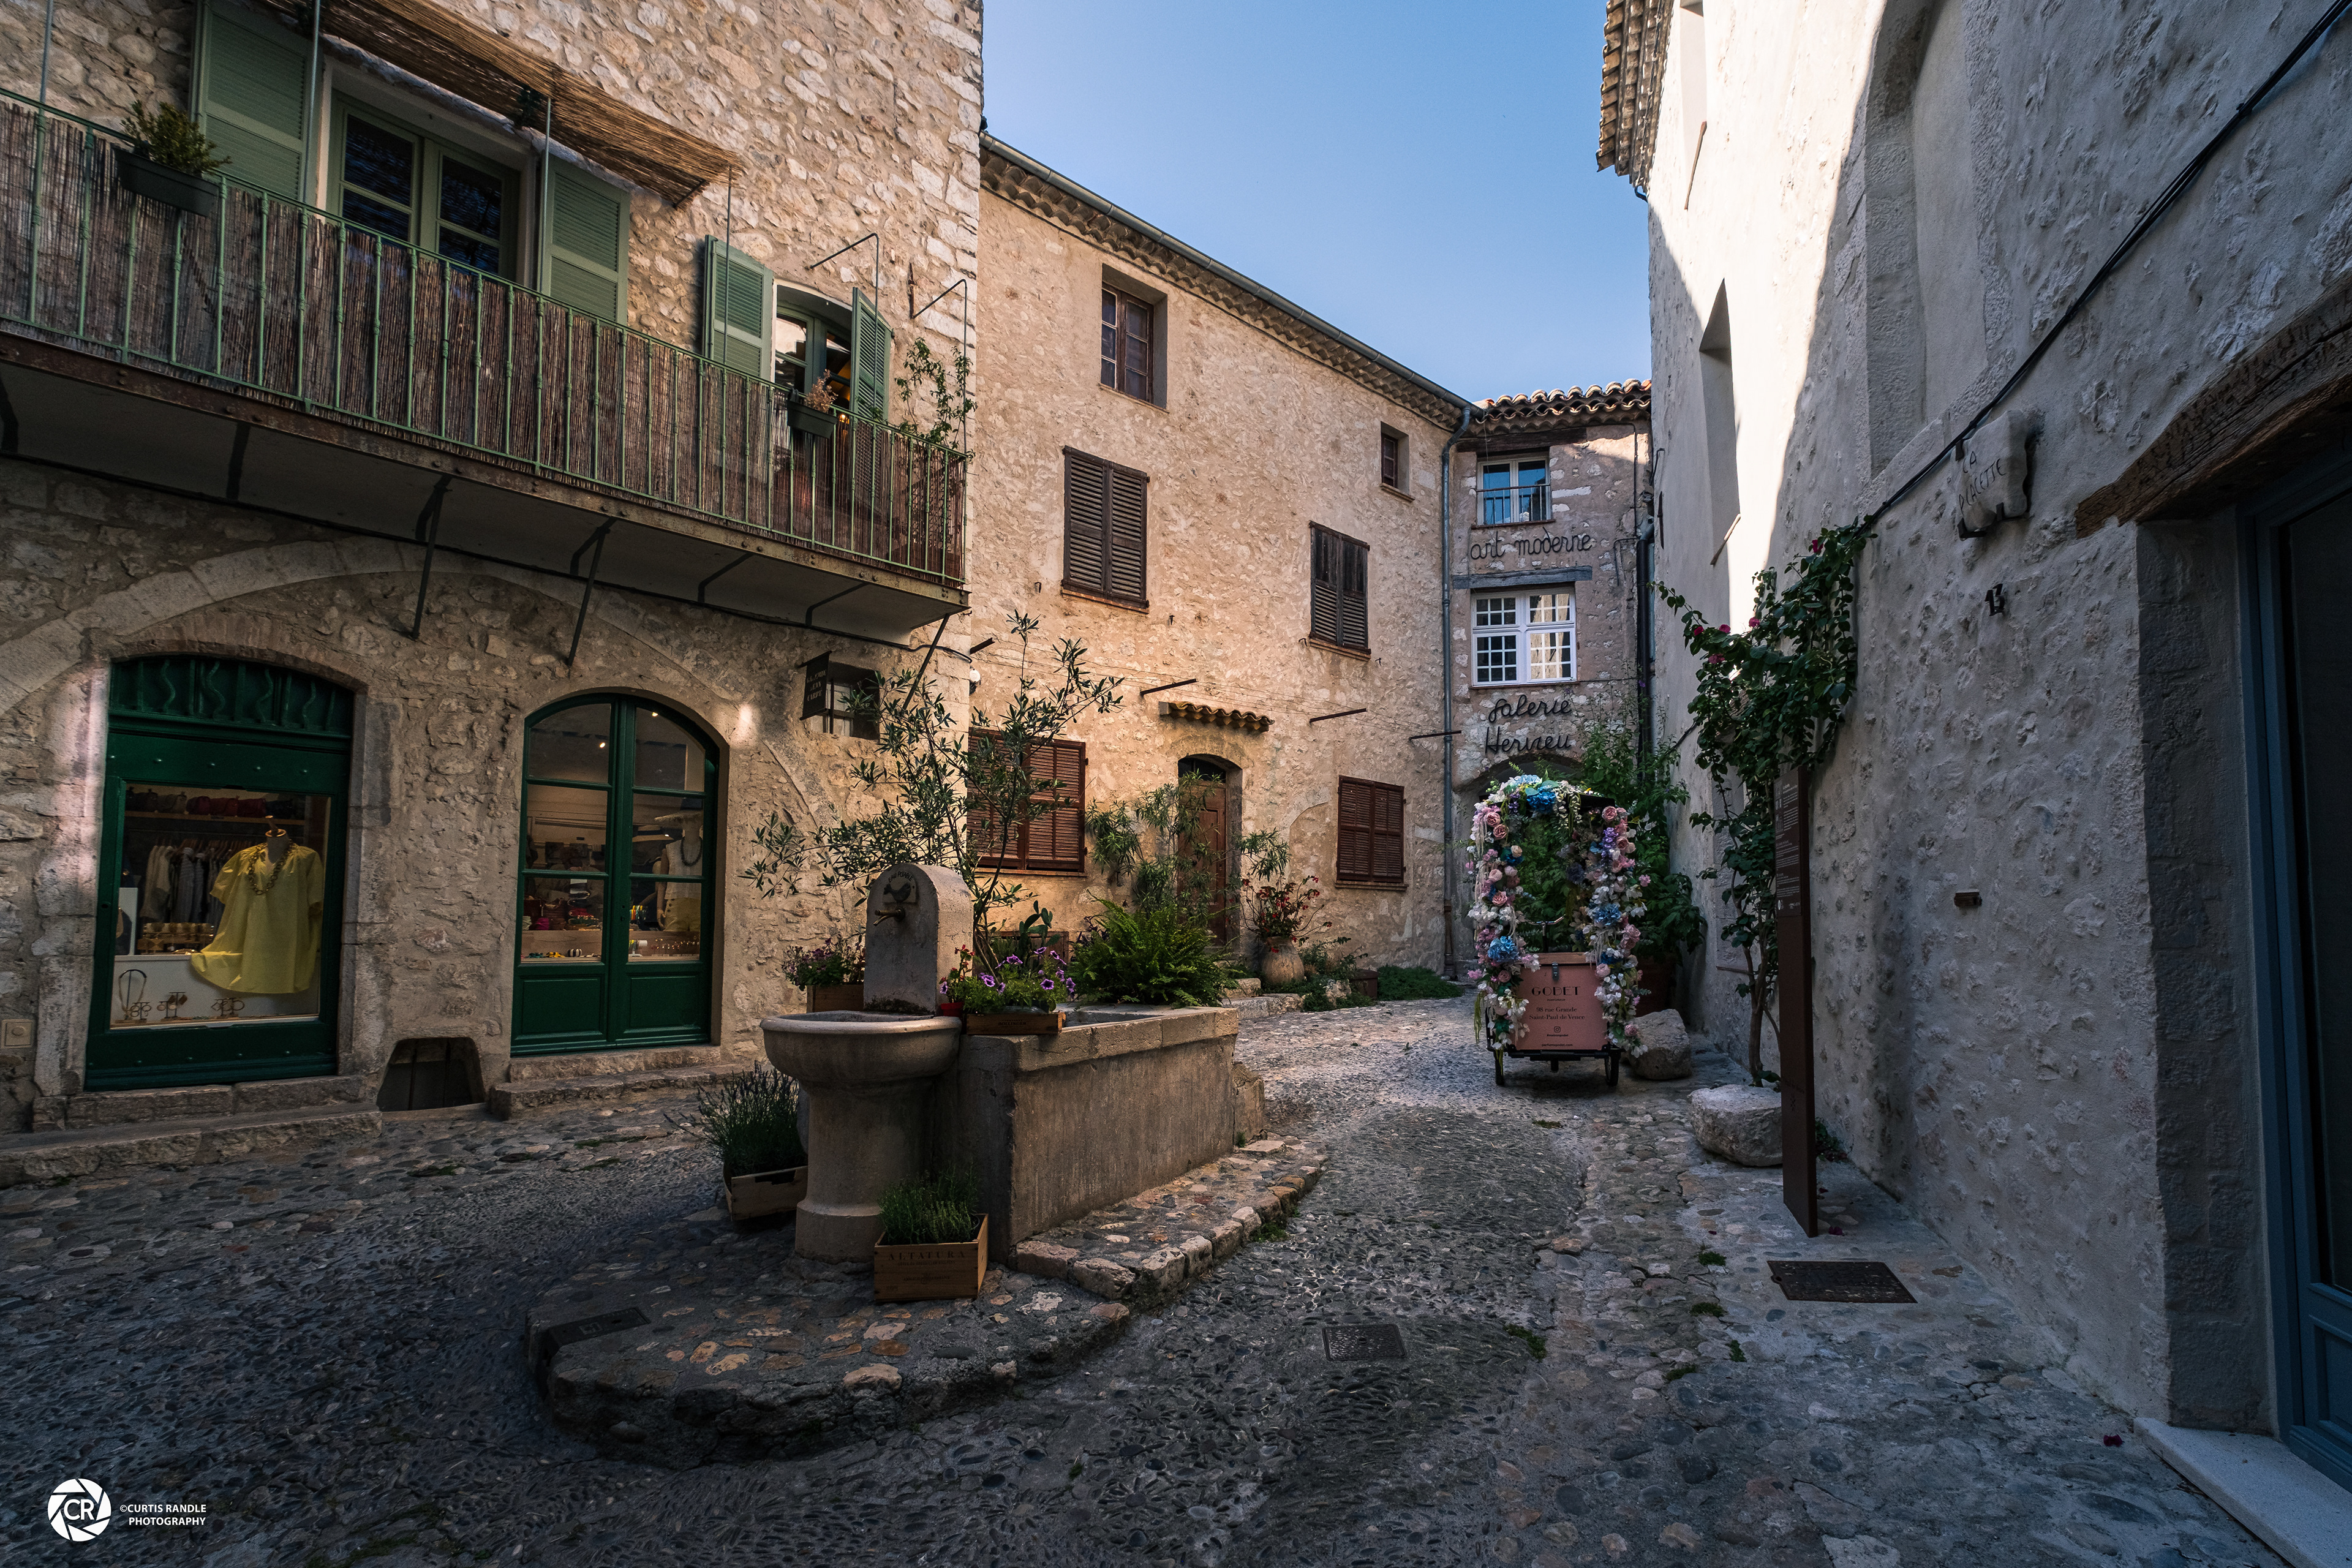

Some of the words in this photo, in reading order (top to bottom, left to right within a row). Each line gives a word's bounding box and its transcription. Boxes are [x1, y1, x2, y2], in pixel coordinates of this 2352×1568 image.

[1959, 458, 2007, 516] PLACETTE
[1471, 531, 1506, 560] art
[1514, 526, 1593, 556] moderne
[1488, 694, 1572, 723] Galerie
[888, 872, 897, 883] EAU
[897, 871, 913, 881] POTABLE
[1531, 986, 1581, 996] GODET
[888, 1251, 965, 1261] ALTATURA
